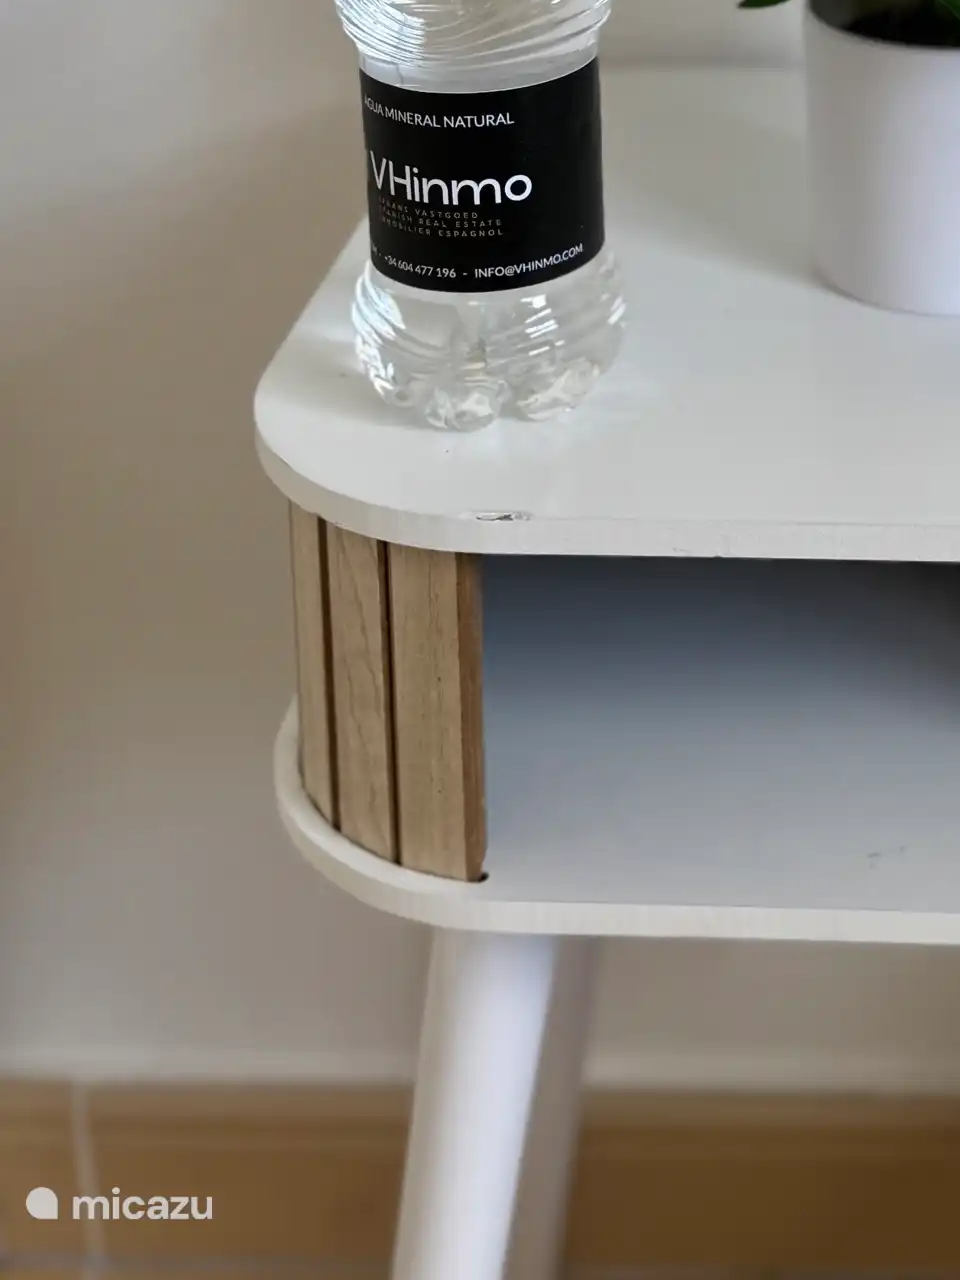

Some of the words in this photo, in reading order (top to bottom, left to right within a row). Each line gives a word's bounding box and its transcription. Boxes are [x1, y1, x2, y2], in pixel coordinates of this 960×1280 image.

[385, 106, 441, 128] MINERAL
[443, 112, 515, 128] NATURAL
[370, 150, 532, 206] VHinmo
[415, 208, 478, 219] VASTGOED
[419, 218, 447, 228] REAL
[455, 219, 502, 228] ESTATE
[438, 228, 504, 237] ESPAGNOL
[398, 259, 413, 272] 604
[415, 264, 434, 276] 477
[436, 267, 456, 278] 196
[474, 243, 583, 278] INFO@VHINMO.COM
